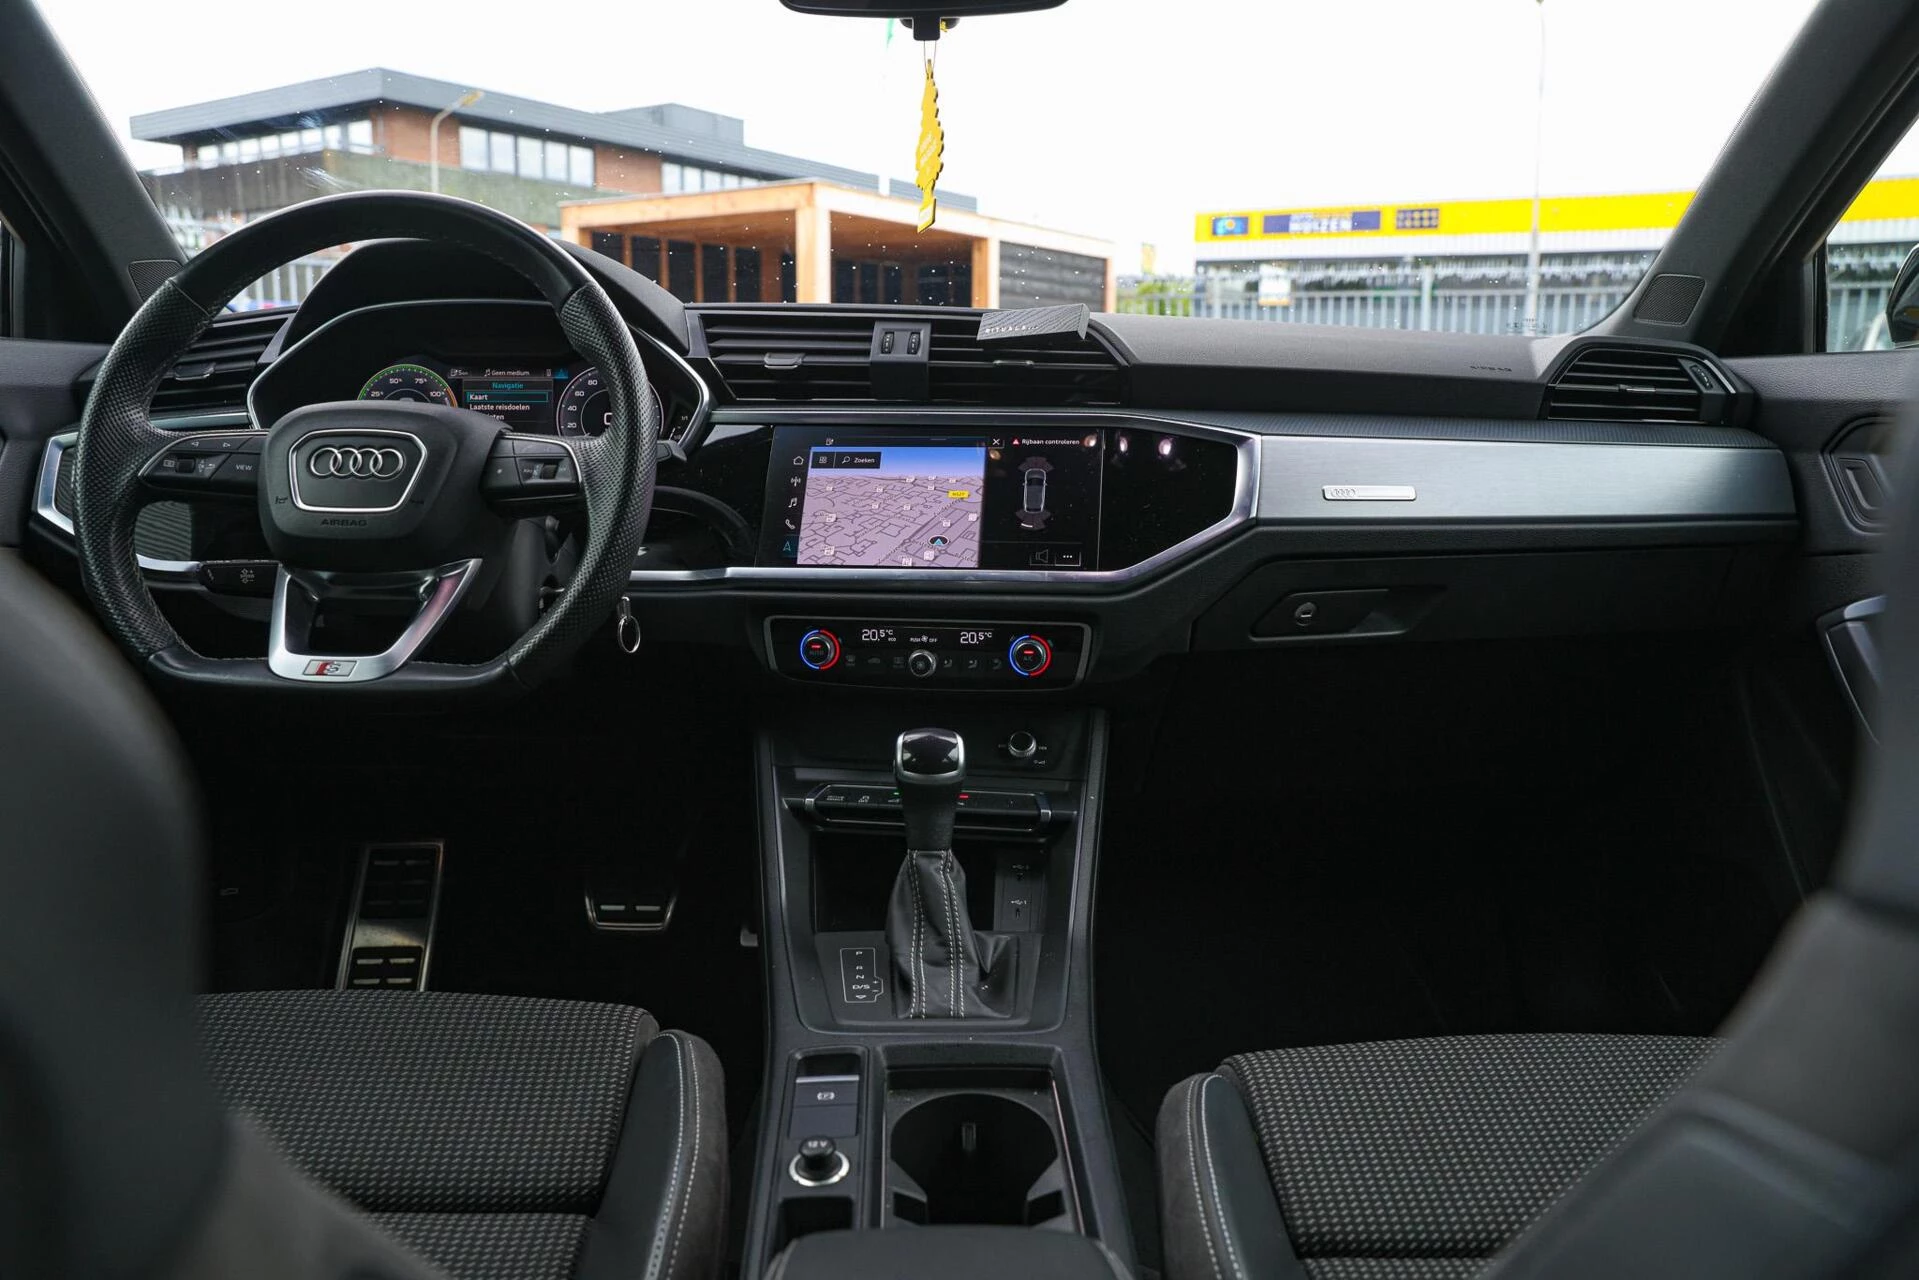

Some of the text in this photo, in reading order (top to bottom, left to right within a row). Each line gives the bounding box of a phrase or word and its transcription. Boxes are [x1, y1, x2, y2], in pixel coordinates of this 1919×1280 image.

[492, 382, 524, 390] Navigatie
[320, 518, 368, 527] AIRBAG
[808, 1140, 828, 1148] 12 V
